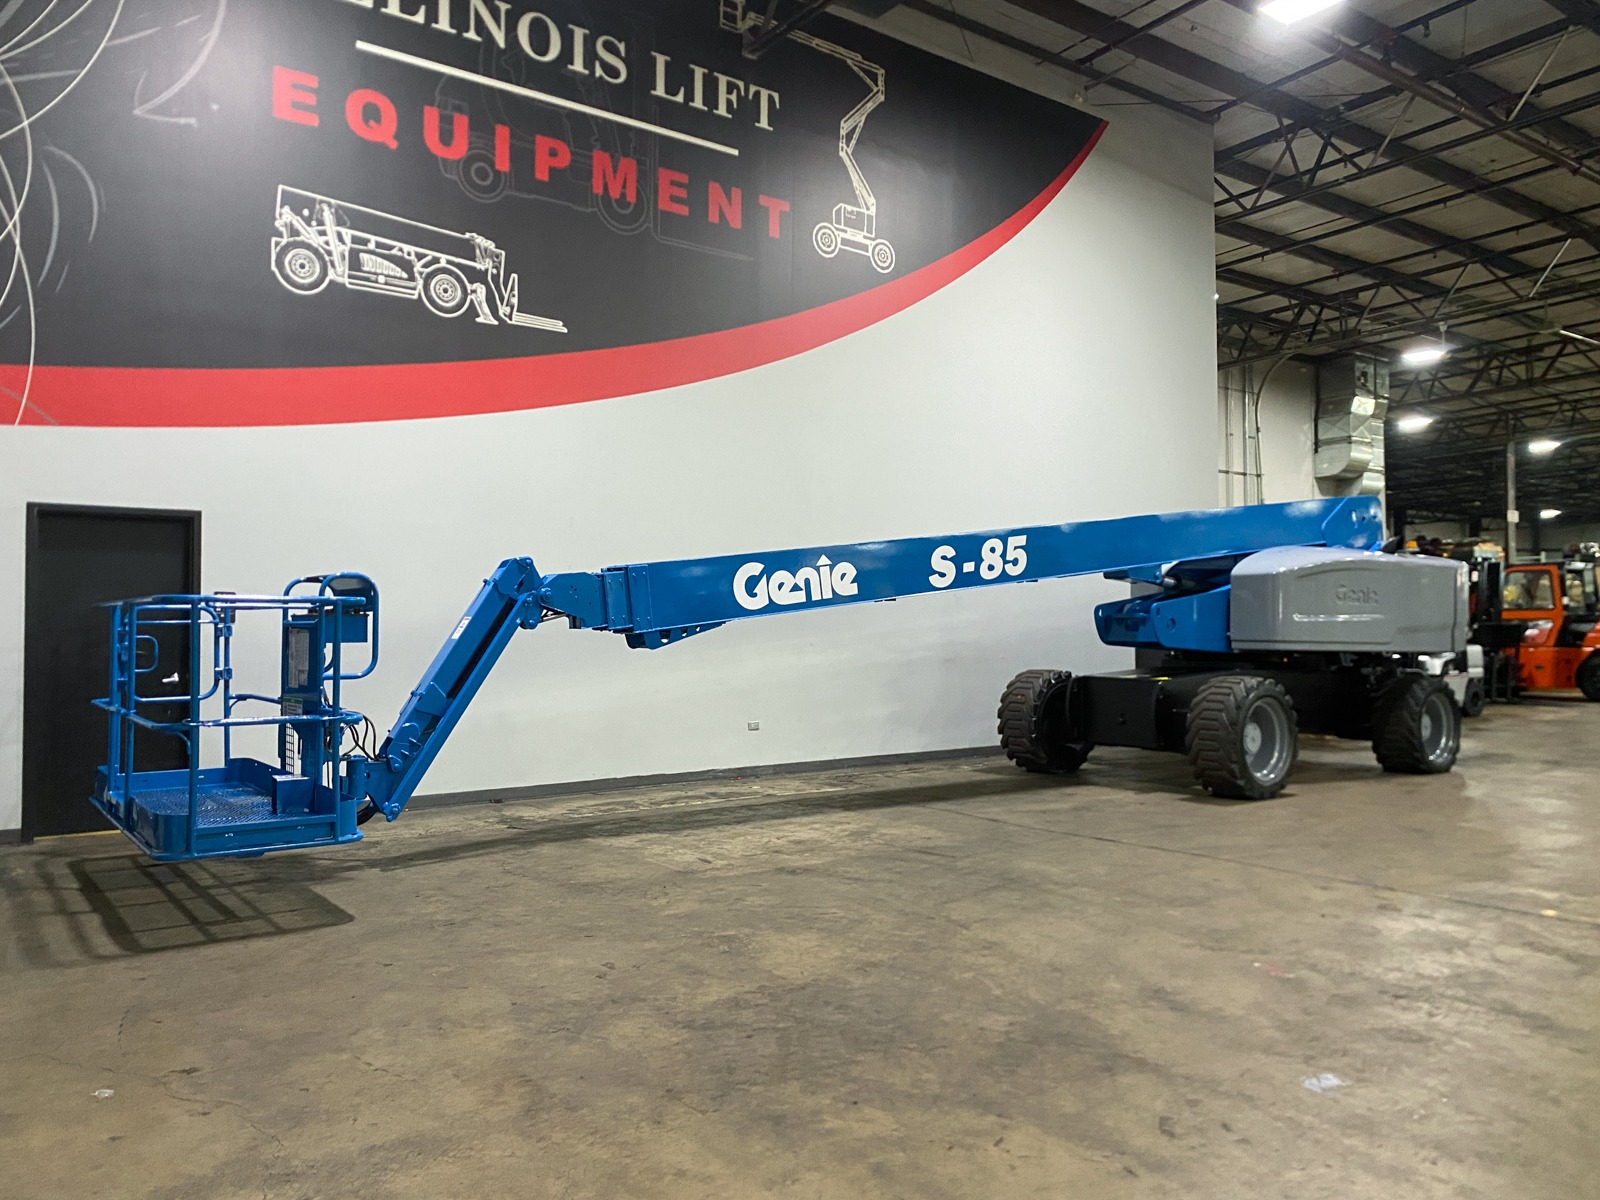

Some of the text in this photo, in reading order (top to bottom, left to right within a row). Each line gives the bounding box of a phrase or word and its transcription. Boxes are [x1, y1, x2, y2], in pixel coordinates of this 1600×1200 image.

[340, 0, 781, 131] INOIS LIFT
[272, 65, 791, 239] EQUIPMENT
[732, 553, 859, 611] Genie
[1335, 583, 1380, 605] Genie
